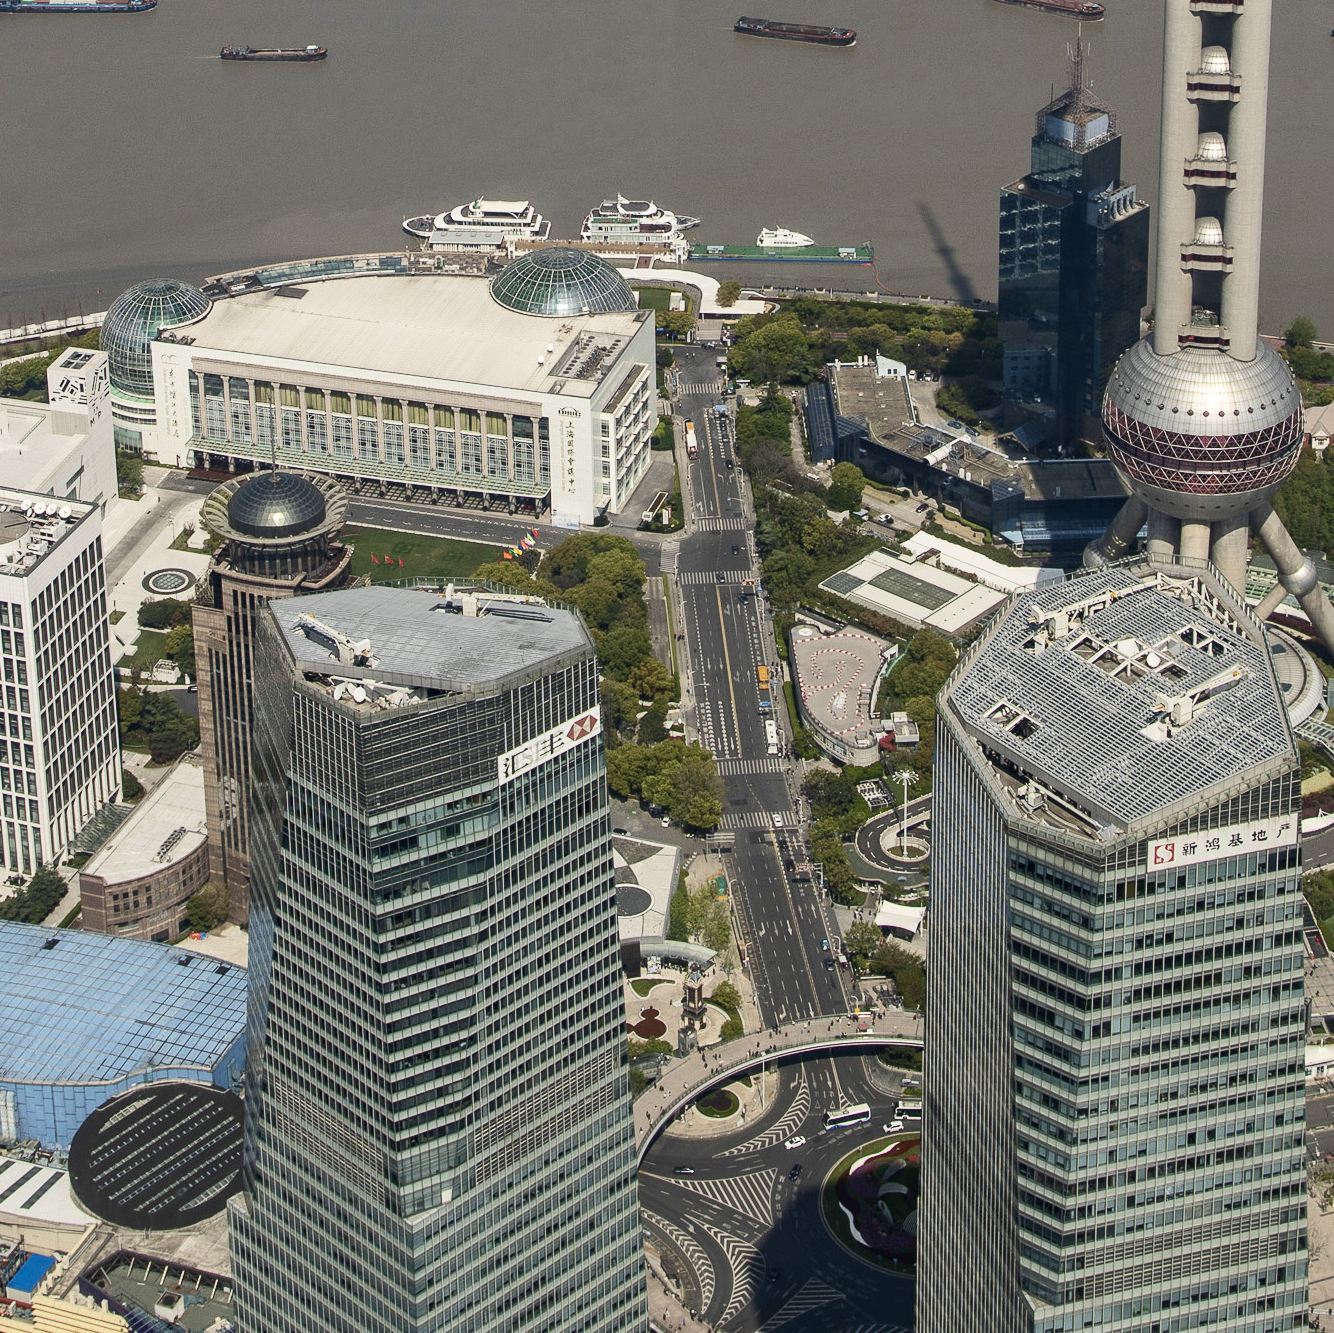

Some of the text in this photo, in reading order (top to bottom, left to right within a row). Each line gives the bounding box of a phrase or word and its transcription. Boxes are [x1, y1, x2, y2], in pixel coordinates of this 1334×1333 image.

[1182, 823, 1291, 856] 新鸿基地产
